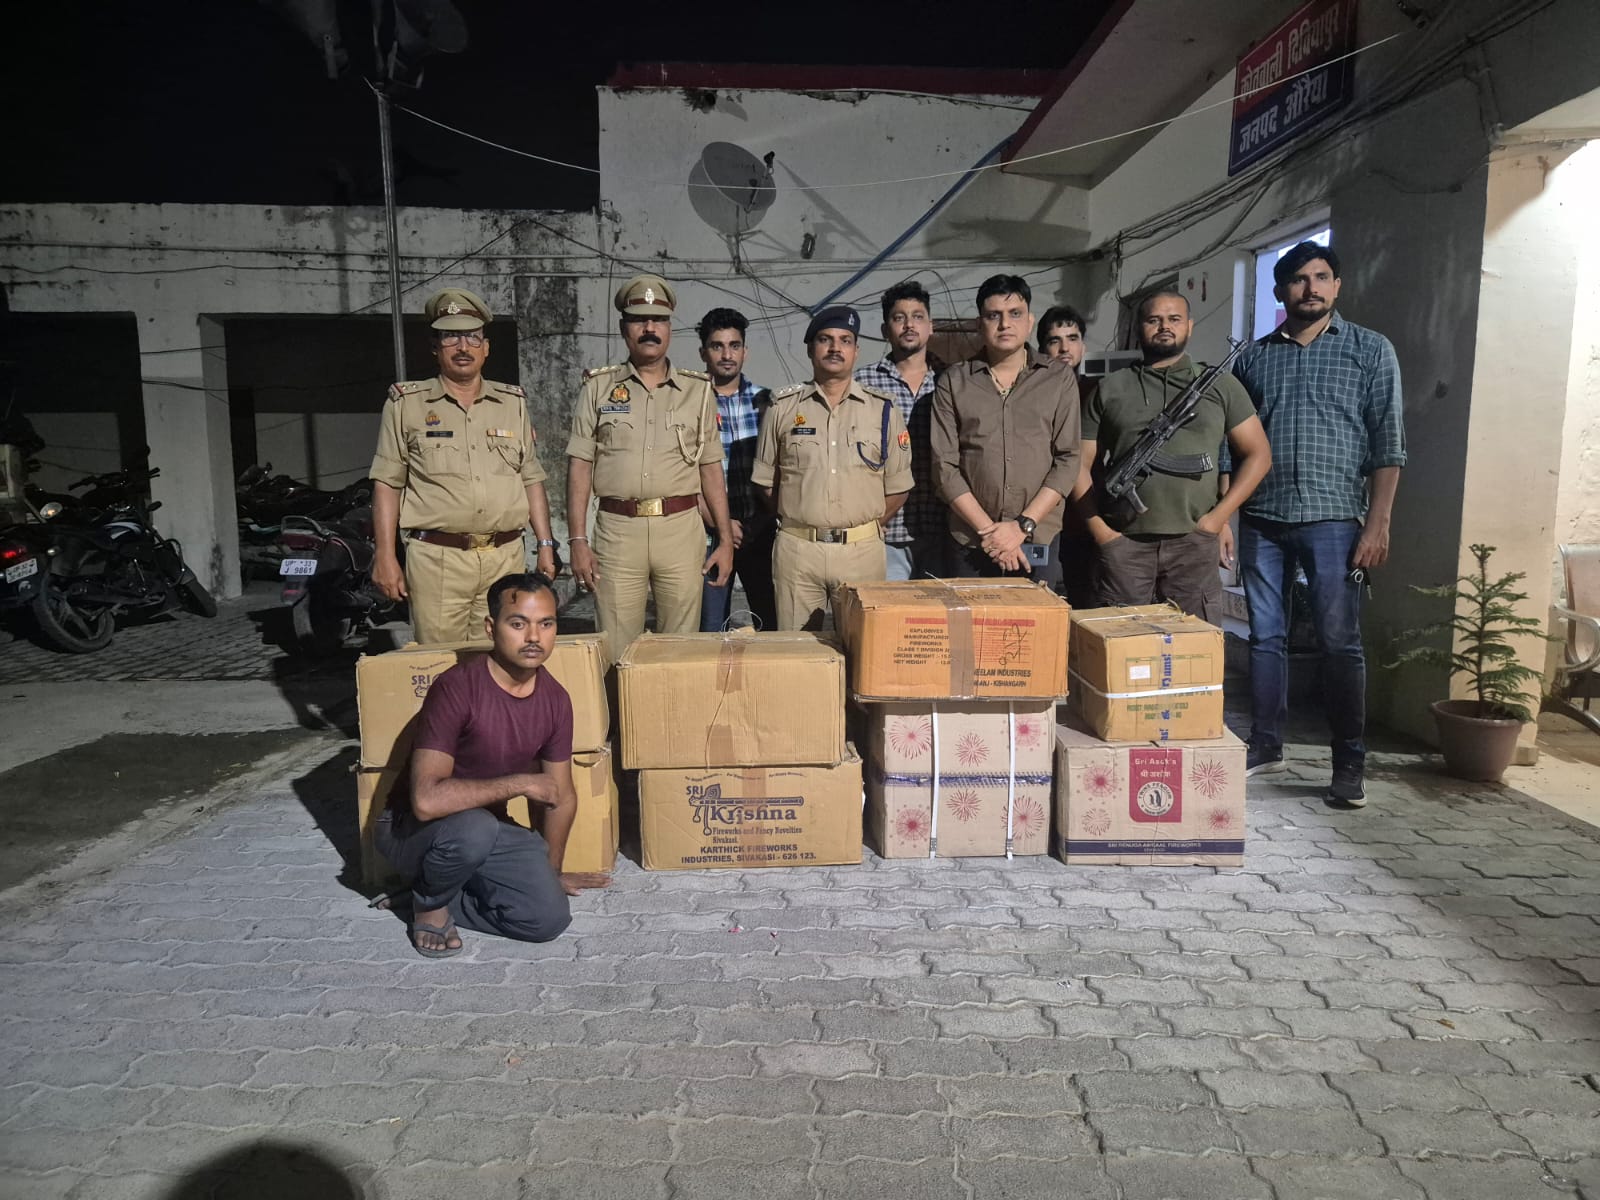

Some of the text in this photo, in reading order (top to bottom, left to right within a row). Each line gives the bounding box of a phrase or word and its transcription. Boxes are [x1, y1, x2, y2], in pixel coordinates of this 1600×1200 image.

[1239, 104, 1279, 154] जनपद
[997, 669, 1031, 677] INDUSTRIES
[411, 674, 431, 685] SRI
[686, 785, 704, 795] SRI
[710, 804, 797, 825] Krishna
[712, 827, 742, 836] Fireworks
[743, 827, 755, 836] and
[756, 827, 773, 837] Fancy
[700, 844, 798, 854] KARTHICK FIREWORKS
[681, 855, 735, 864] INDUSTRIES,
[736, 853, 775, 863] SIVAKASI
